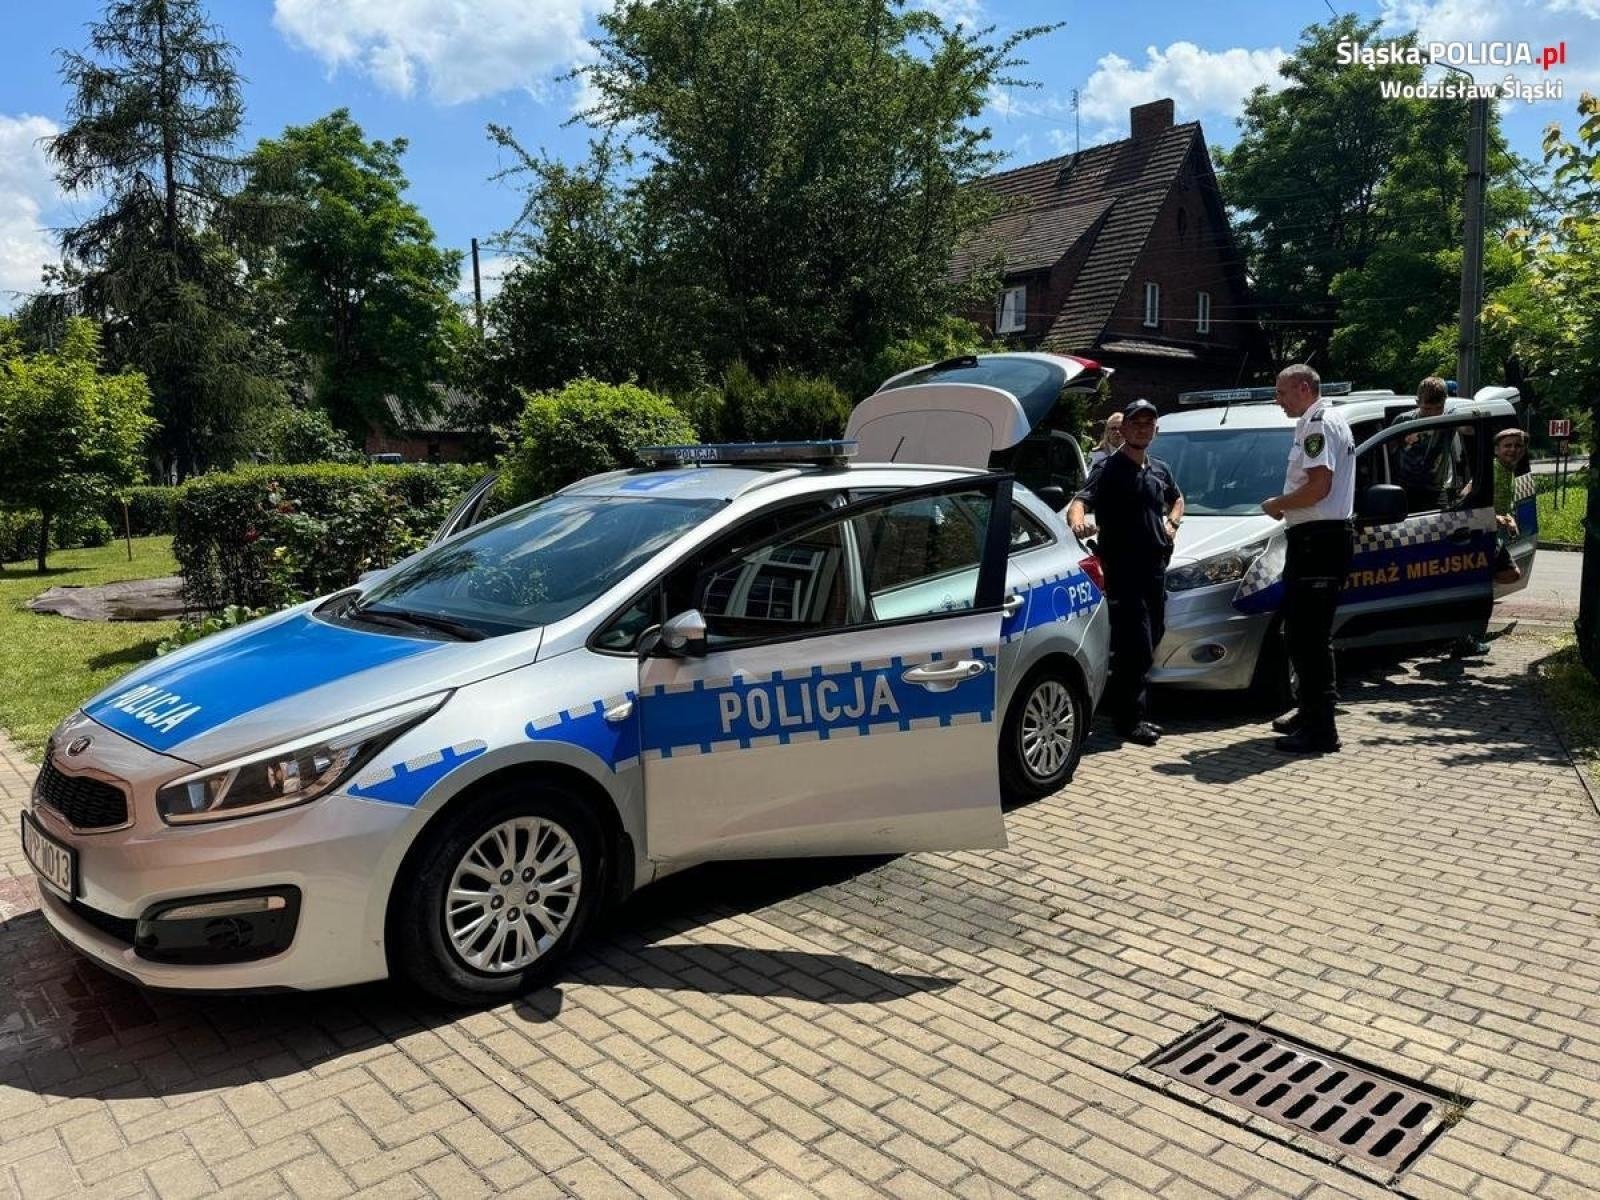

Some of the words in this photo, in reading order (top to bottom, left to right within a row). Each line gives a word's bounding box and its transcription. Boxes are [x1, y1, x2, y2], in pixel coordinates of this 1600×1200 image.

[1406, 551, 1489, 580] MIEJSKA
[105, 684, 202, 733] POLICJA
[718, 674, 900, 734] POLICJA
